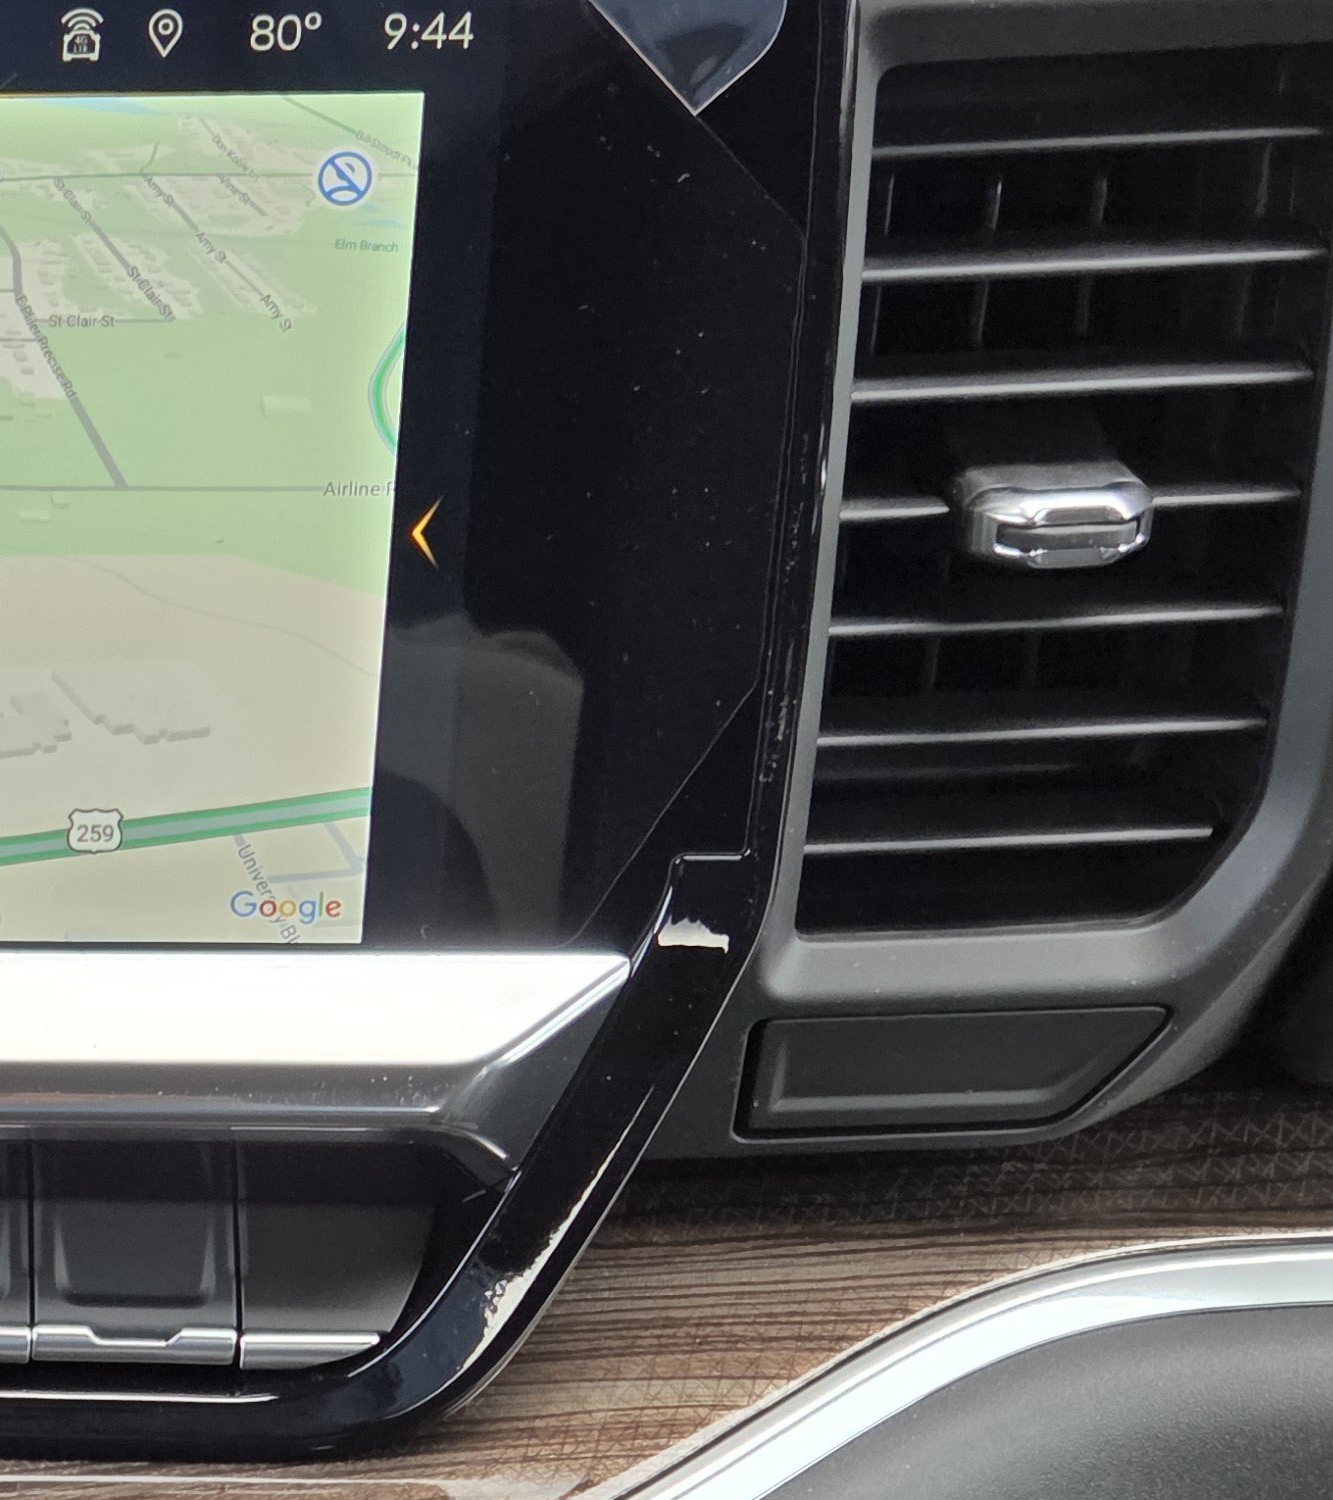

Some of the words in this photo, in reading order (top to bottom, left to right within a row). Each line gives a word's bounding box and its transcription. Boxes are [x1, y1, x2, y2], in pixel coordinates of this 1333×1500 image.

[250, 11, 322, 52] 80°
[384, 11, 475, 51] 9:44
[335, 239, 357, 251] Elm
[360, 239, 399, 252] Branch
[127, 265, 141, 282] St
[137, 279, 161, 308] Clair
[158, 303, 174, 319] St
[48, 315, 63, 328] St
[66, 315, 98, 328] Clair
[101, 315, 115, 328] St
[279, 318, 293, 333] St
[36, 337, 67, 384] Precise
[58, 376, 77, 398] Rd
[323, 480, 381, 497] Airline
[76, 823, 115, 846] 259
[230, 890, 342, 925] Google
